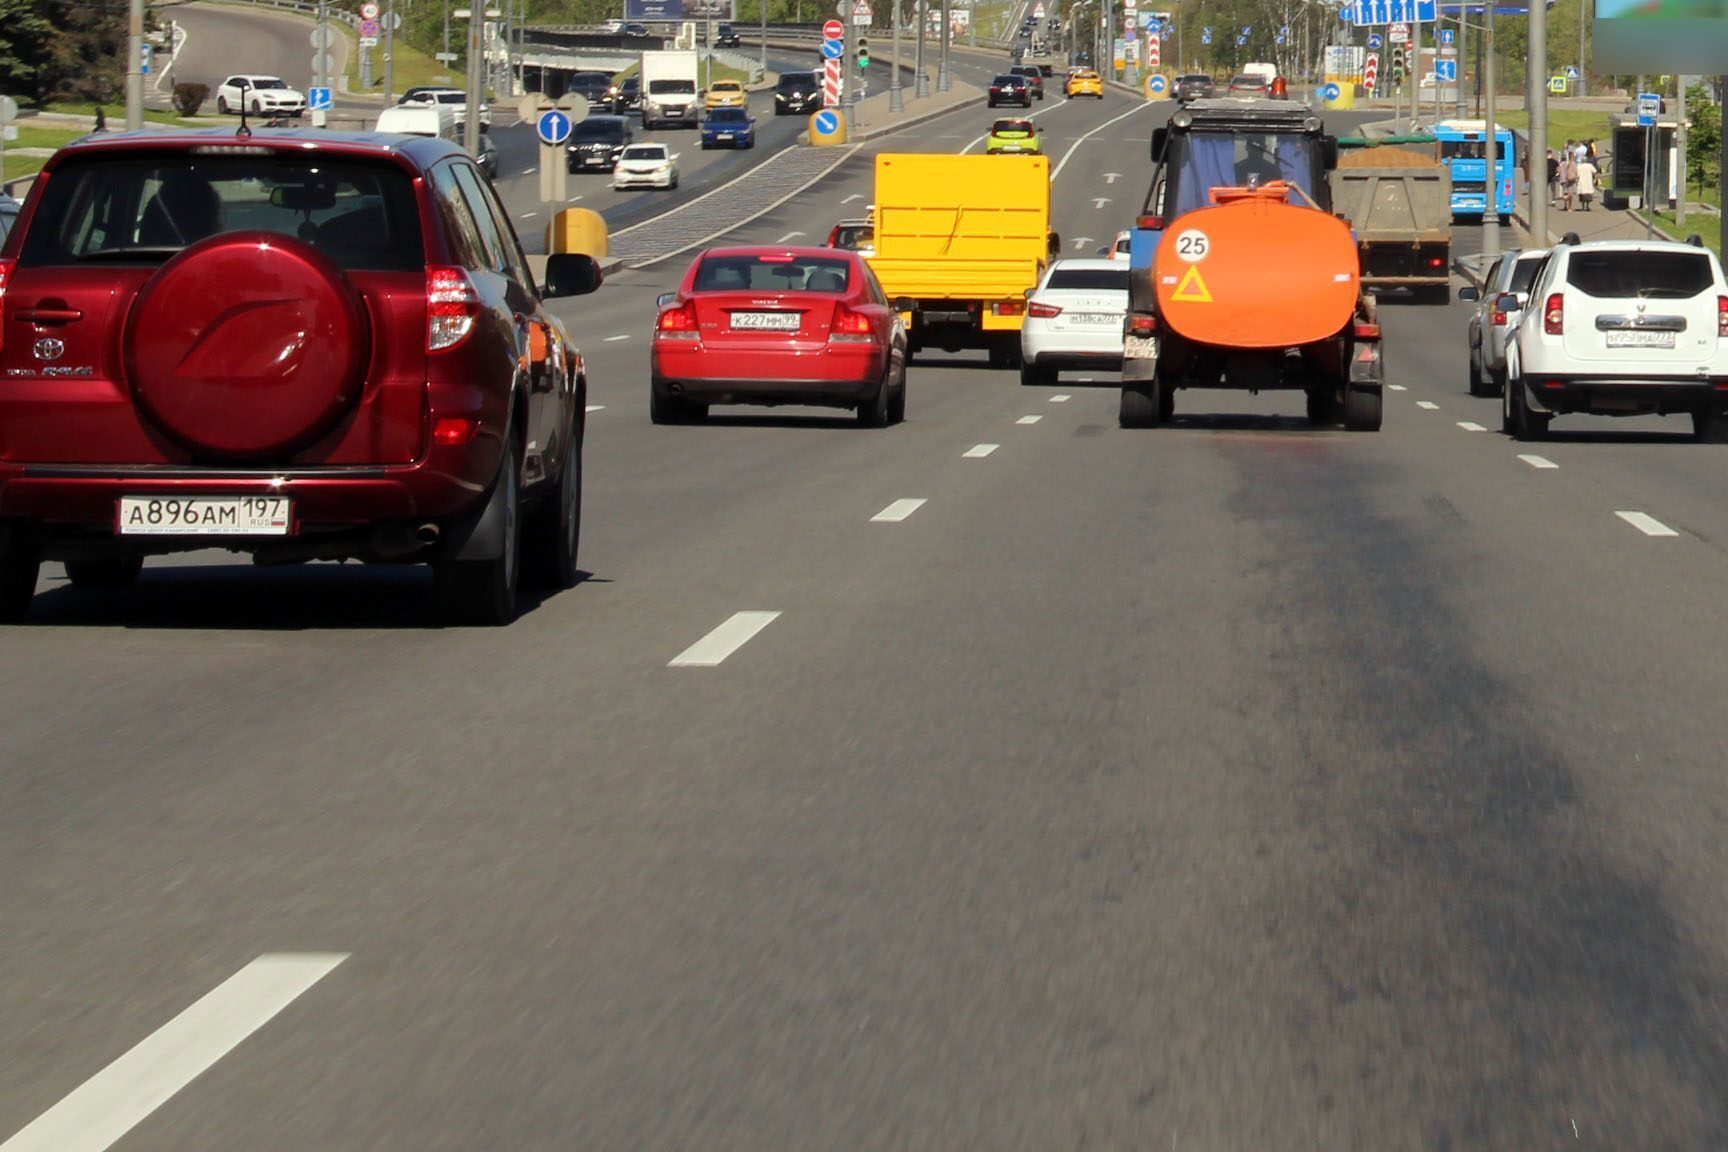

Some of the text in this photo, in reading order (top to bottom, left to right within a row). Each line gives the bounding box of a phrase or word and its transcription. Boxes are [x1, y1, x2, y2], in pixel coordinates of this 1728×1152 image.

[1179, 236, 1206, 255] 25
[129, 499, 281, 525] А896АМ 197
[250, 518, 271, 526] RUS
